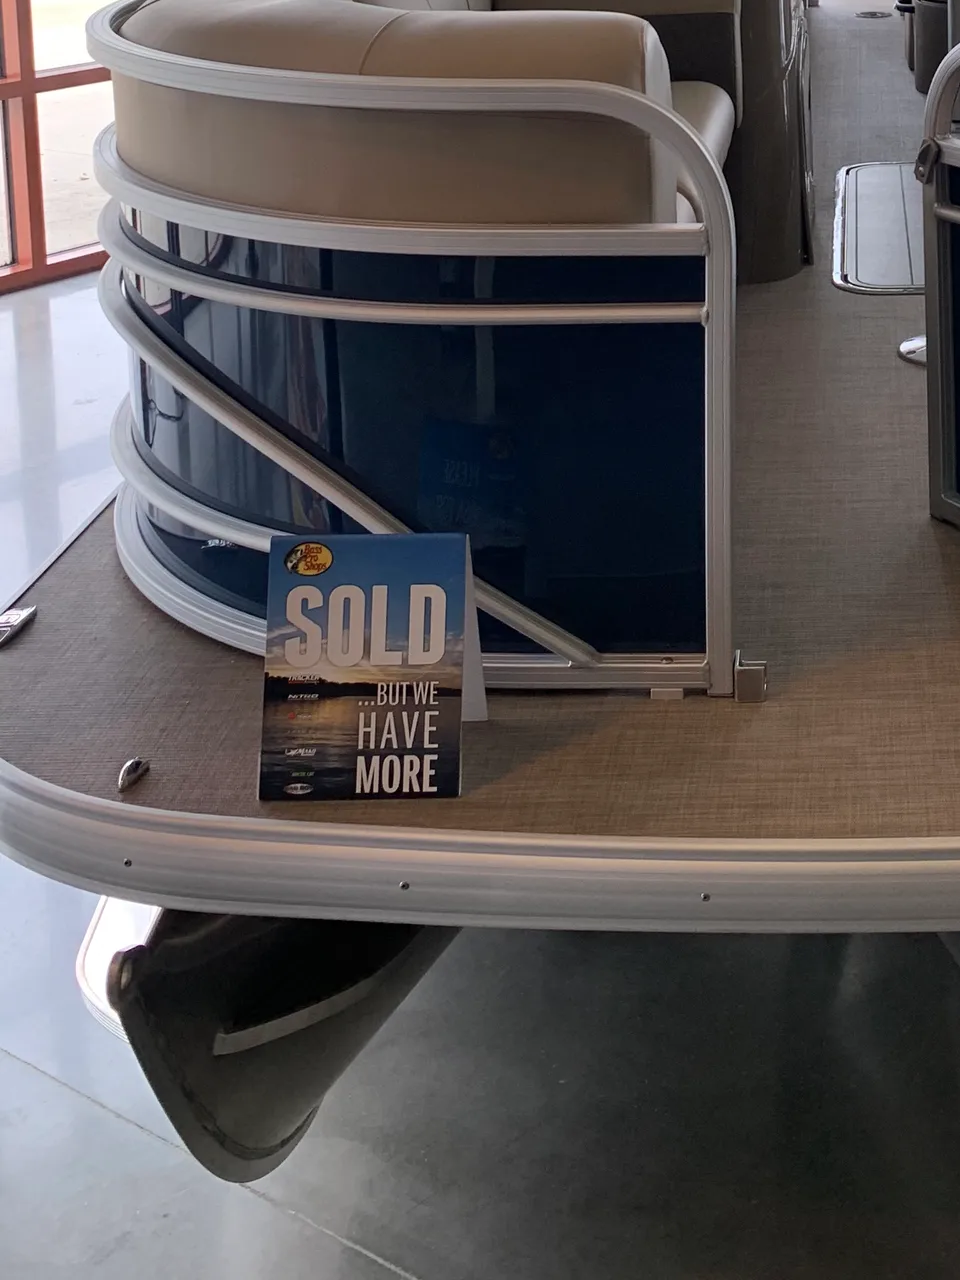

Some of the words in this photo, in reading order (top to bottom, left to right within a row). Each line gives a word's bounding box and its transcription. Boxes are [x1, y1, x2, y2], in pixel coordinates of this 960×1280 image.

[304, 544, 323, 554] Bass
[304, 554, 319, 562] Pro
[303, 561, 327, 572] Shops
[285, 584, 447, 668] SOLD
[413, 681, 439, 705] WE
[357, 711, 439, 750] HAVE
[355, 754, 438, 794] MORE
